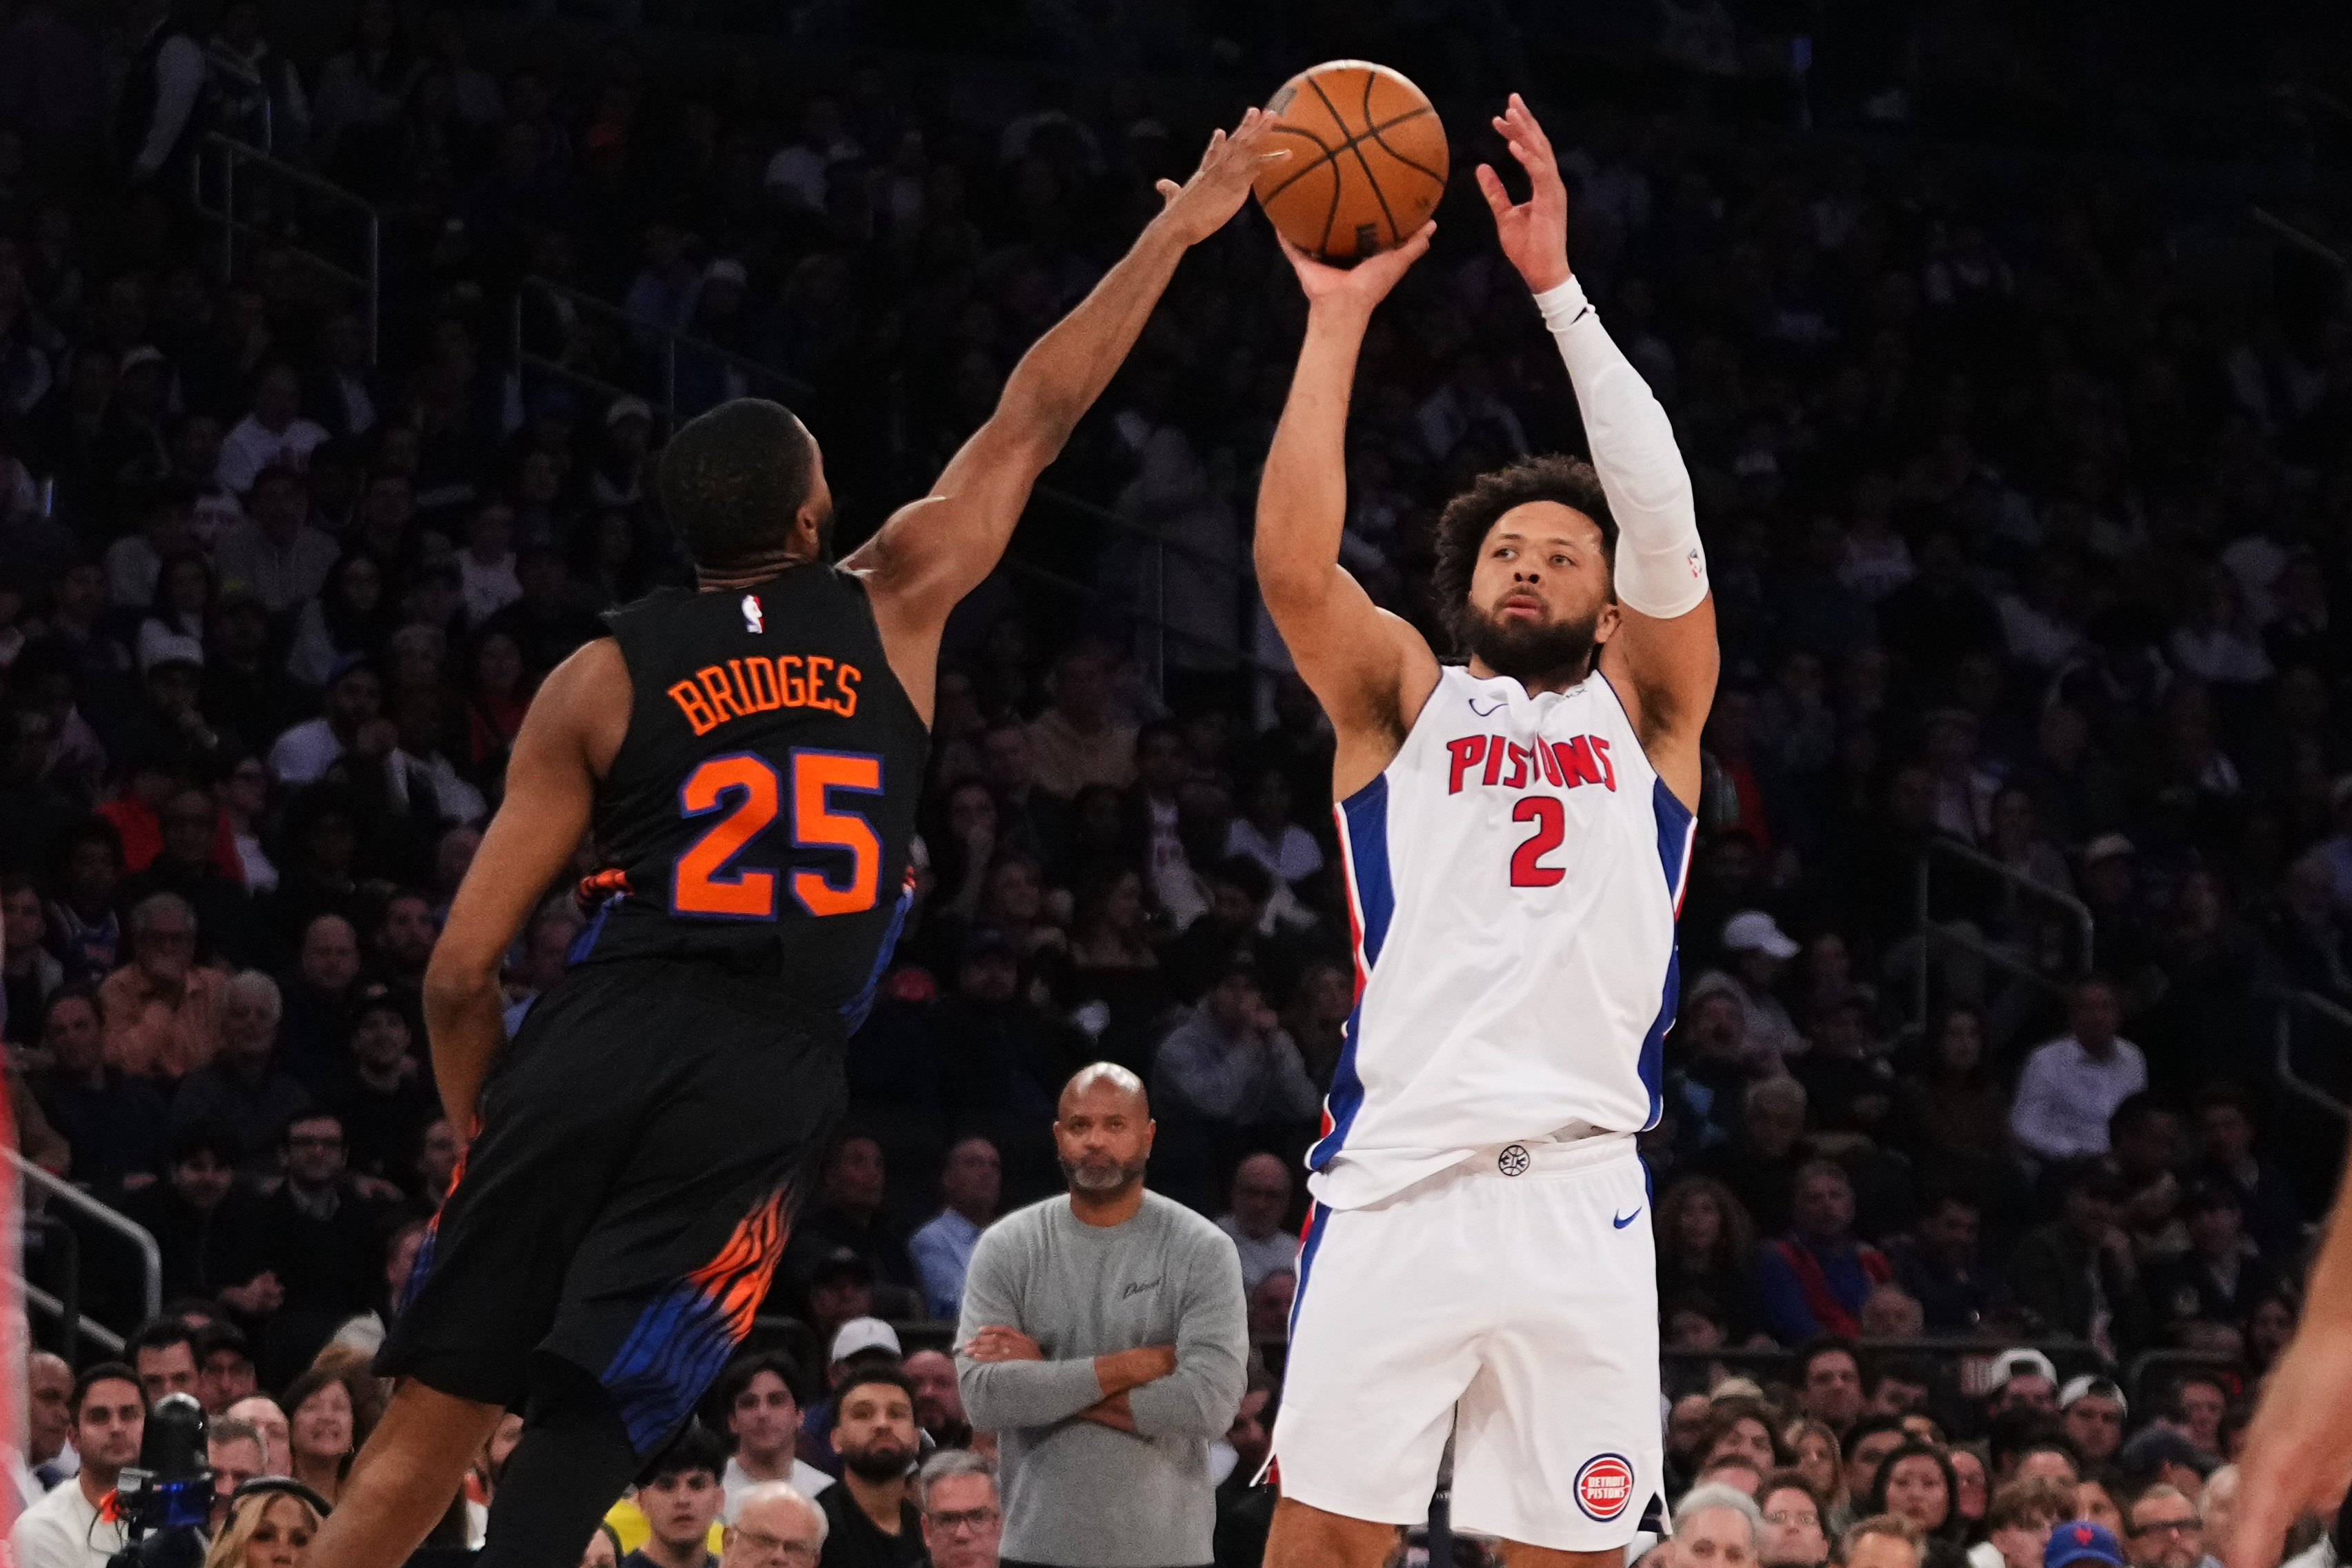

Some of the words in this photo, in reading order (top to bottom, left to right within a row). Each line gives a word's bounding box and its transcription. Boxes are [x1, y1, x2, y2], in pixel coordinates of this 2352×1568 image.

[668, 655, 862, 736] BRIDGES
[670, 746, 884, 922] 25
[1510, 795, 1566, 887] 2
[1587, 1488, 1625, 1499] PISTONS
[1588, 1476, 1625, 1487] DETROIT
